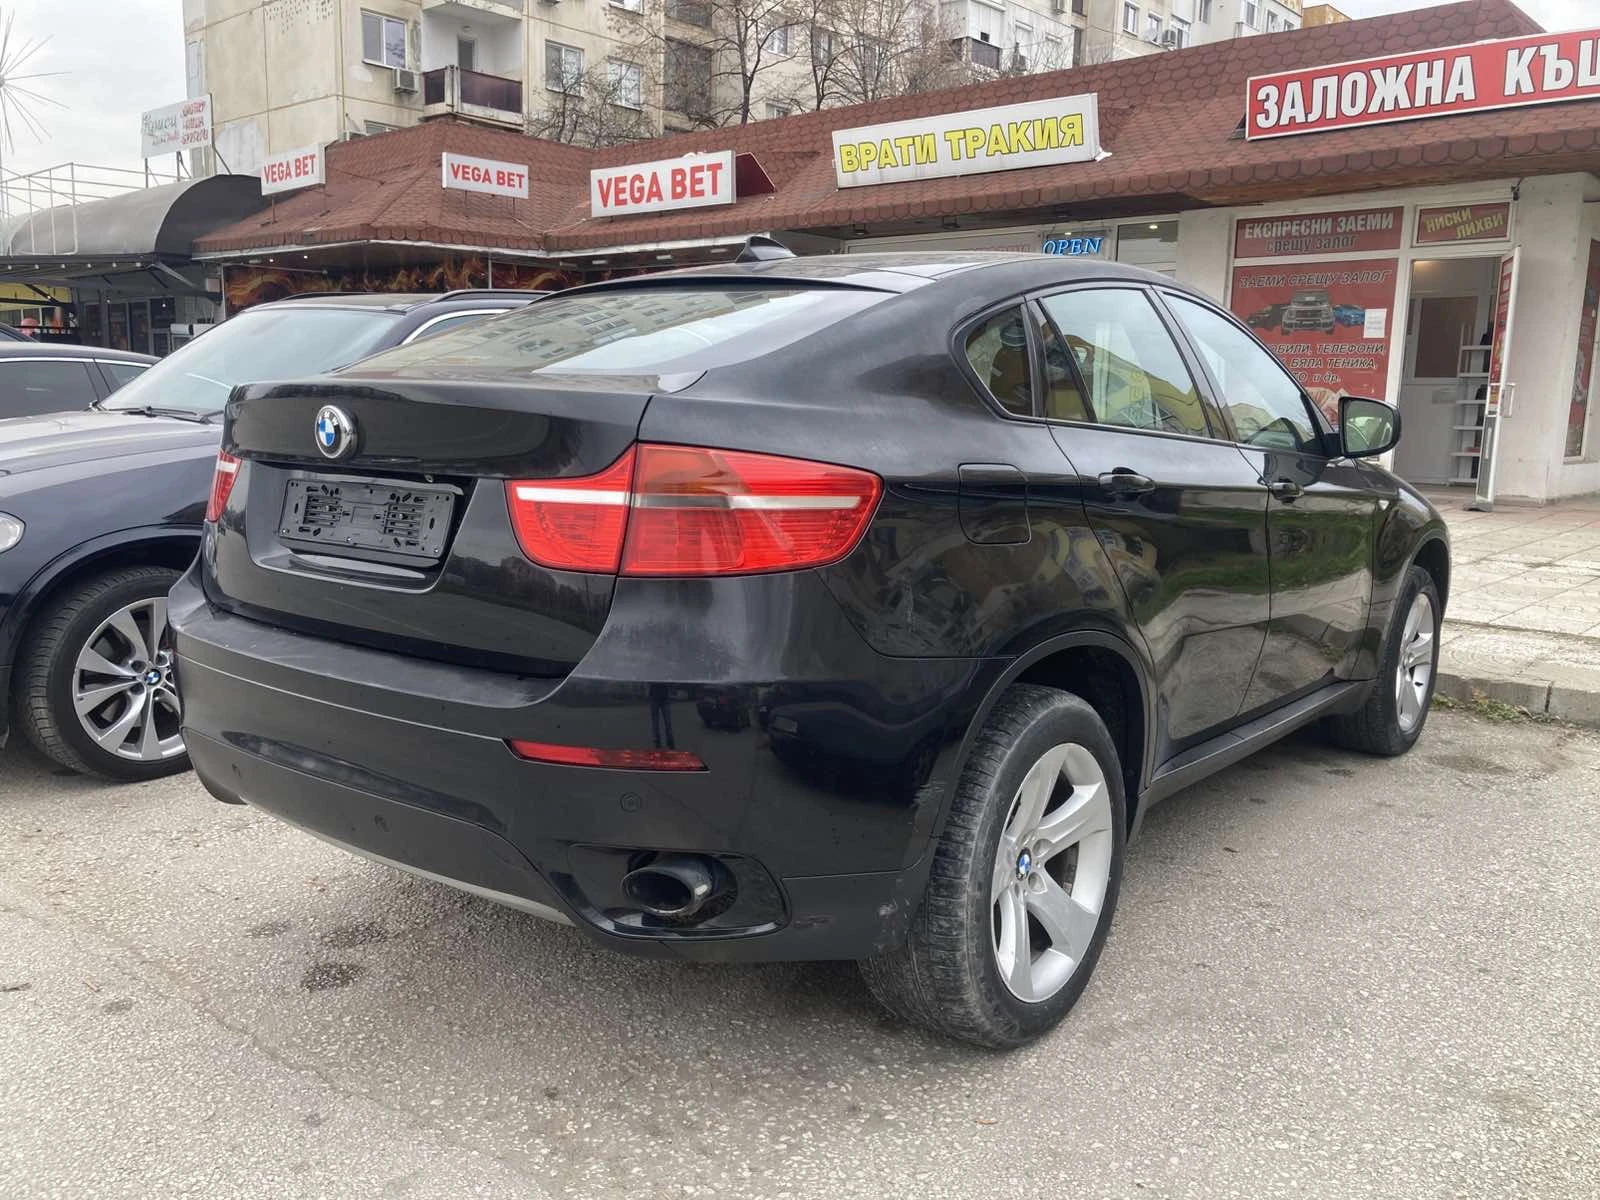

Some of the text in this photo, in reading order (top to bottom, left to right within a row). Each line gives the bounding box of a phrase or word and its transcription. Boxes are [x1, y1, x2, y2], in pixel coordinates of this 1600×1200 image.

[1255, 55, 1476, 130] ЗАЛОЖНА
[839, 113, 1084, 173] ВРАТИ ТРАКИЯ
[263, 153, 317, 185] VEGA BET
[450, 162, 526, 190] VEGA BET
[597, 162, 724, 209] VEGA BET
[1244, 212, 1394, 239] ЕКСПРЕСНИ ЗАЕМИ
[1424, 207, 1473, 233] НИСКИ
[1455, 212, 1505, 240] ЛИХВИ
[1042, 236, 1104, 257] OPEN
[1240, 269, 1393, 289] ЗАЕМИ СРЕЩУ ЗАЛОГ
